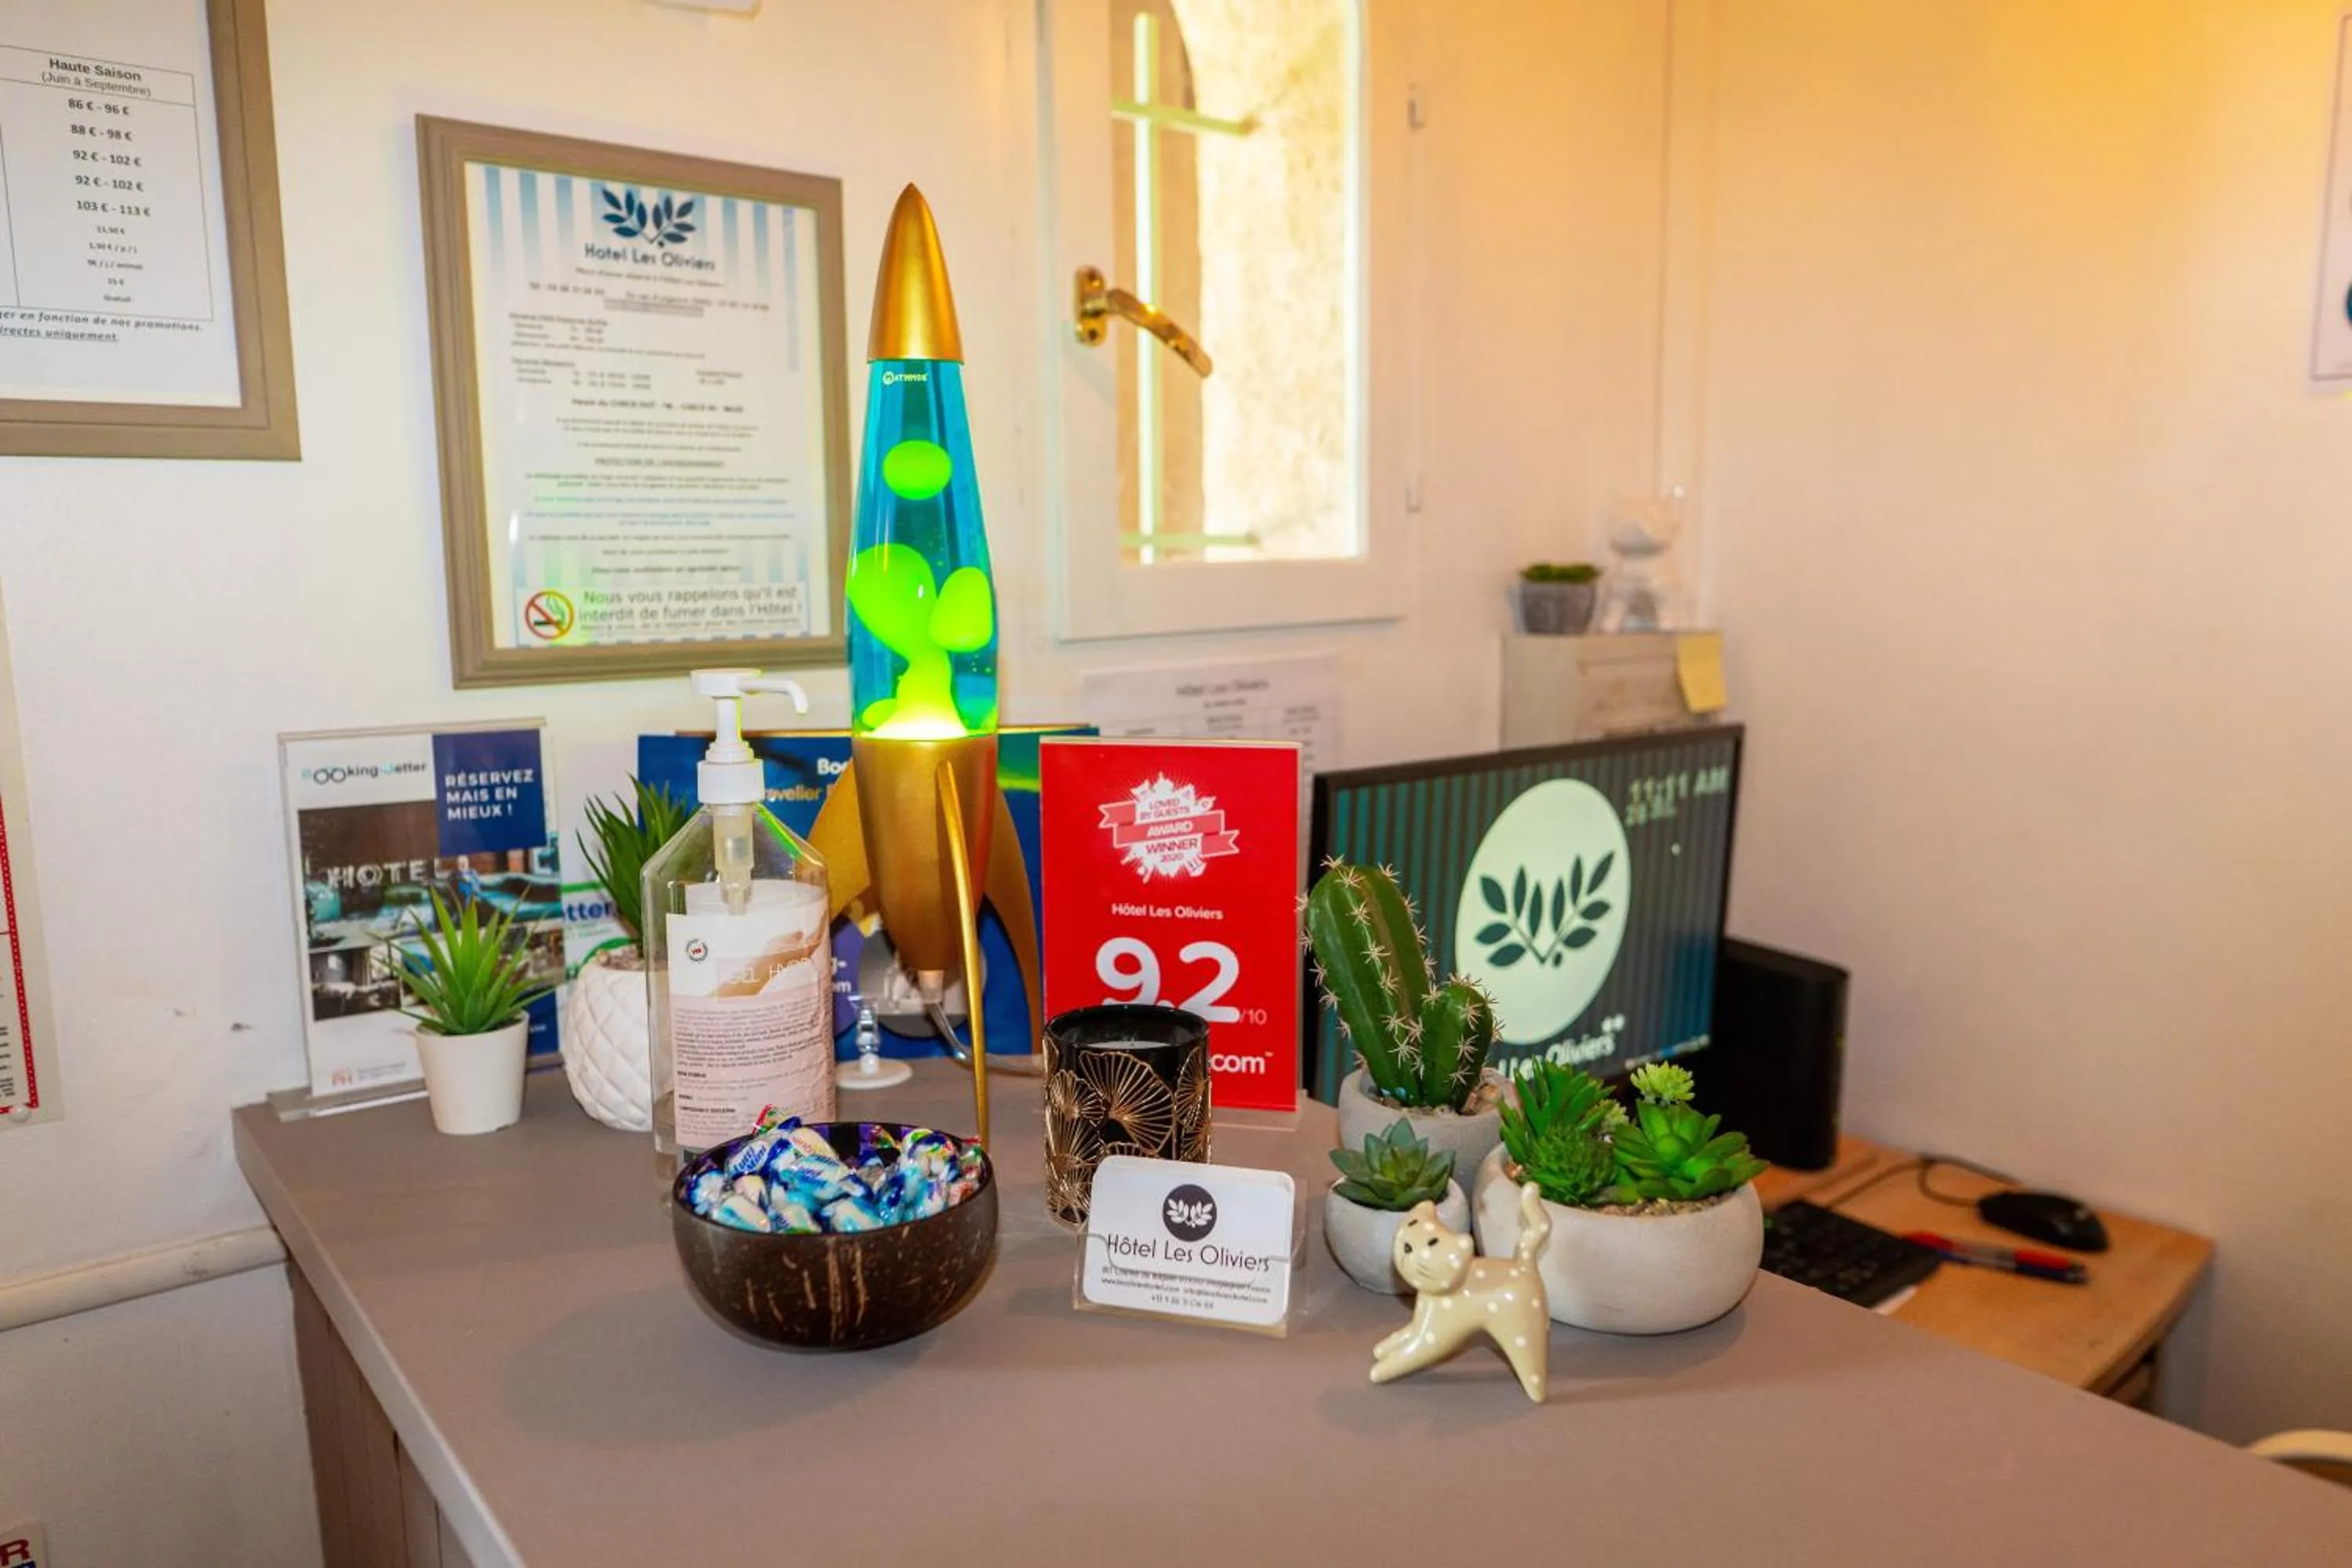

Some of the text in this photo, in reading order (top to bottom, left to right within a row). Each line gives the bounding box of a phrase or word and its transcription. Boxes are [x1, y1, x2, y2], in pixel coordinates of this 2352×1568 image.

[49, 57, 142, 82] Haute Saison
[42, 71, 71, 84] (Juin
[85, 77, 151, 96] Septembre)
[38, 313, 89, 324] fonction
[445, 769, 535, 787] RÉSERVEZ
[446, 786, 518, 803] MAIS EN
[1149, 797, 1179, 811] LOVED
[1153, 806, 1190, 817] GUESTS
[447, 805, 503, 821] MIEUX
[1147, 821, 1192, 837] AWARD
[1145, 838, 1198, 855] WINNER
[327, 858, 452, 888] HOTEL
[1112, 902, 1224, 920] Hôtel Les Oliviers
[1107, 1233, 1156, 1258] Hôtel
[1164, 1240, 1192, 1263] Les
[1200, 1244, 1270, 1272] Oliviers
